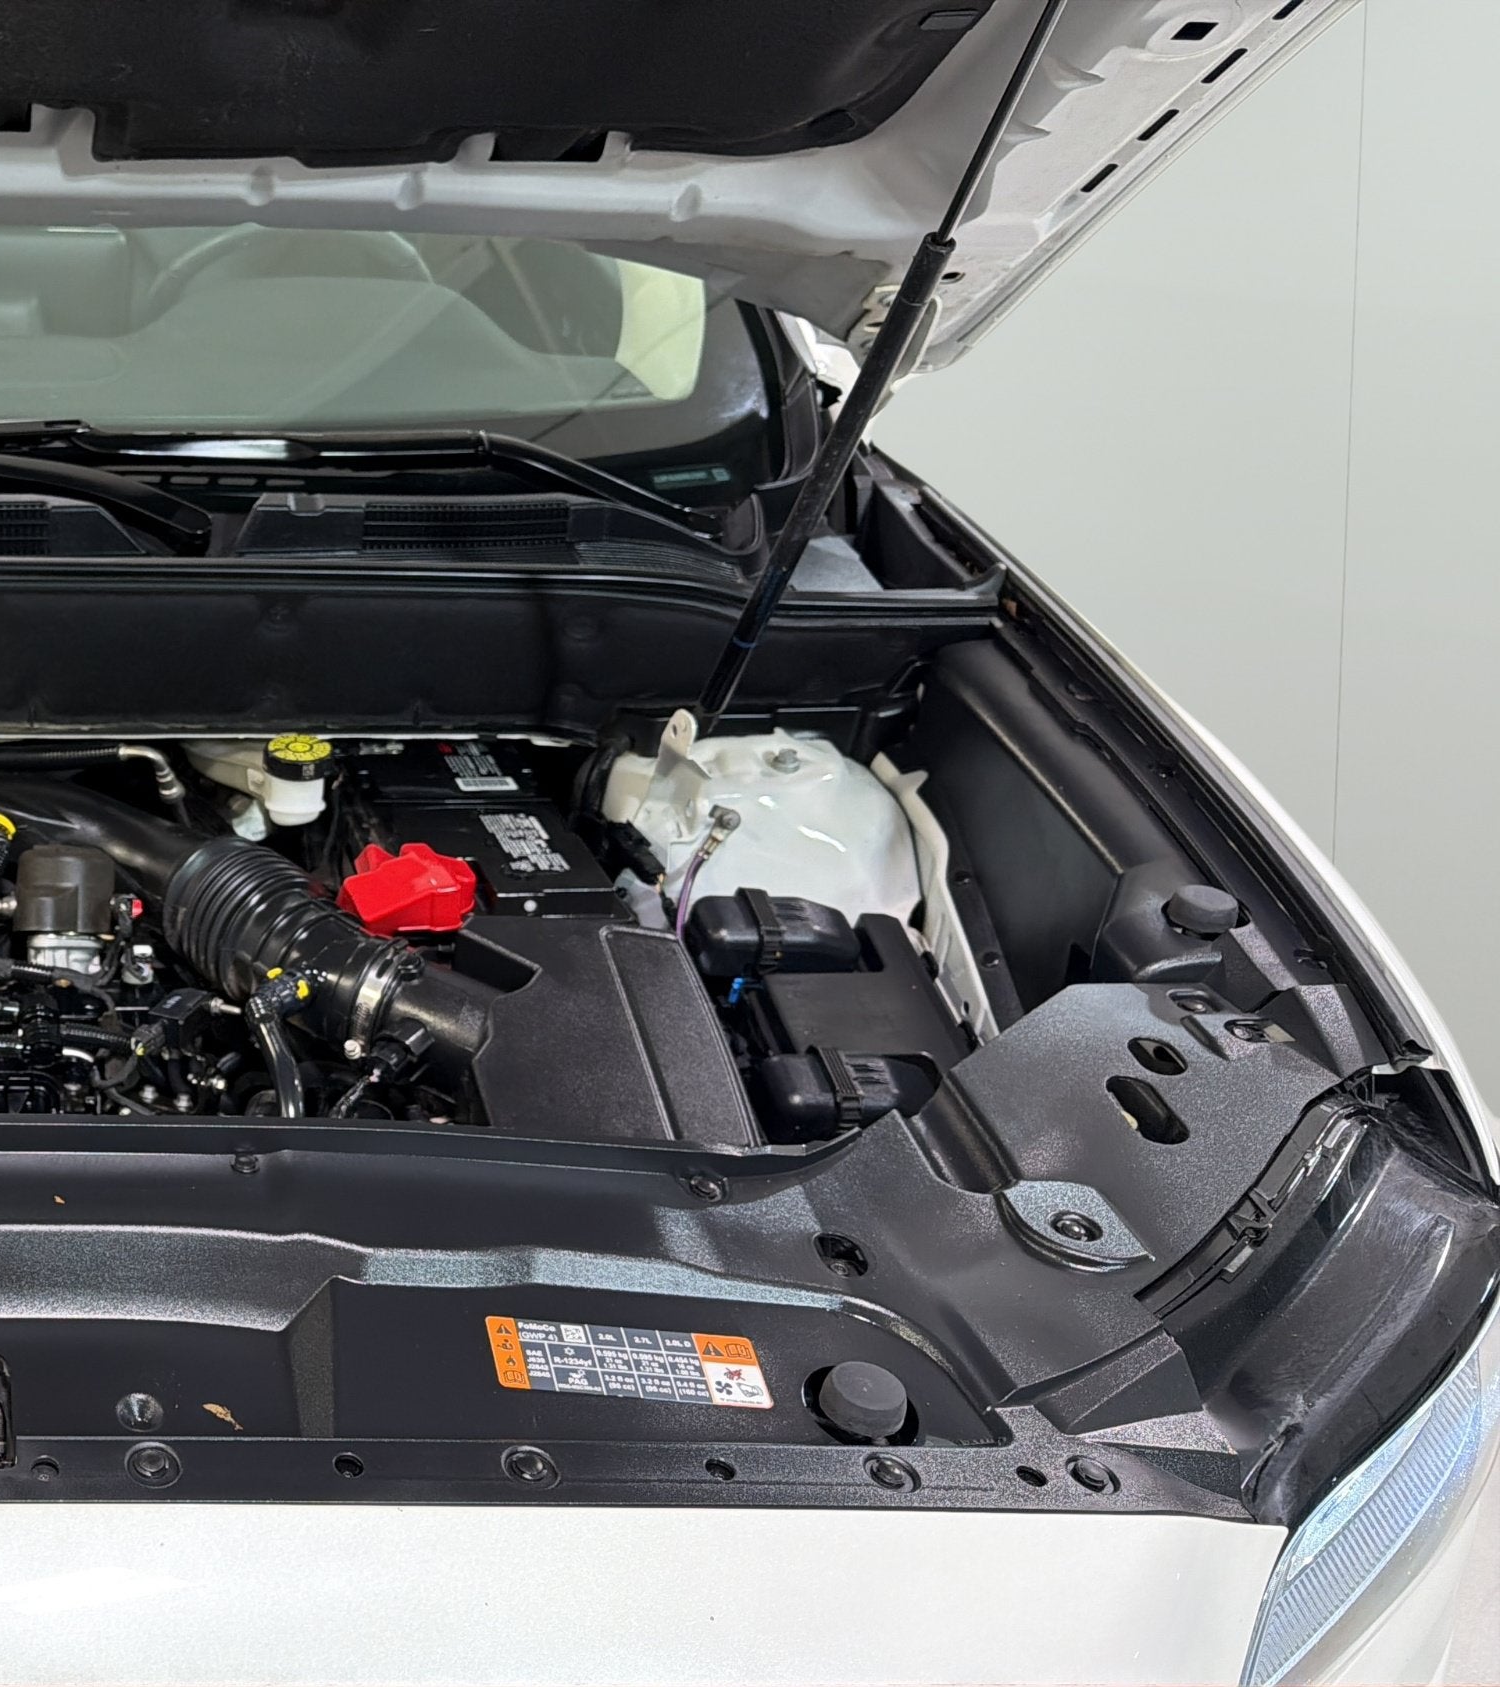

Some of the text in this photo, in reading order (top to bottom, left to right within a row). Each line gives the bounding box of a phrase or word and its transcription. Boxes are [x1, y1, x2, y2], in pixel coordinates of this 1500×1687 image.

[518, 1322, 556, 1332] FoMoCo
[519, 1331, 558, 1342] (GWP 4)
[598, 1333, 617, 1341] 2.0L
[665, 1339, 683, 1347] 2.0L
[618, 1352, 628, 1360] kg
[654, 1355, 664, 1363] kg
[554, 1356, 592, 1366] R-1234yf
[689, 1358, 700, 1366] kg
